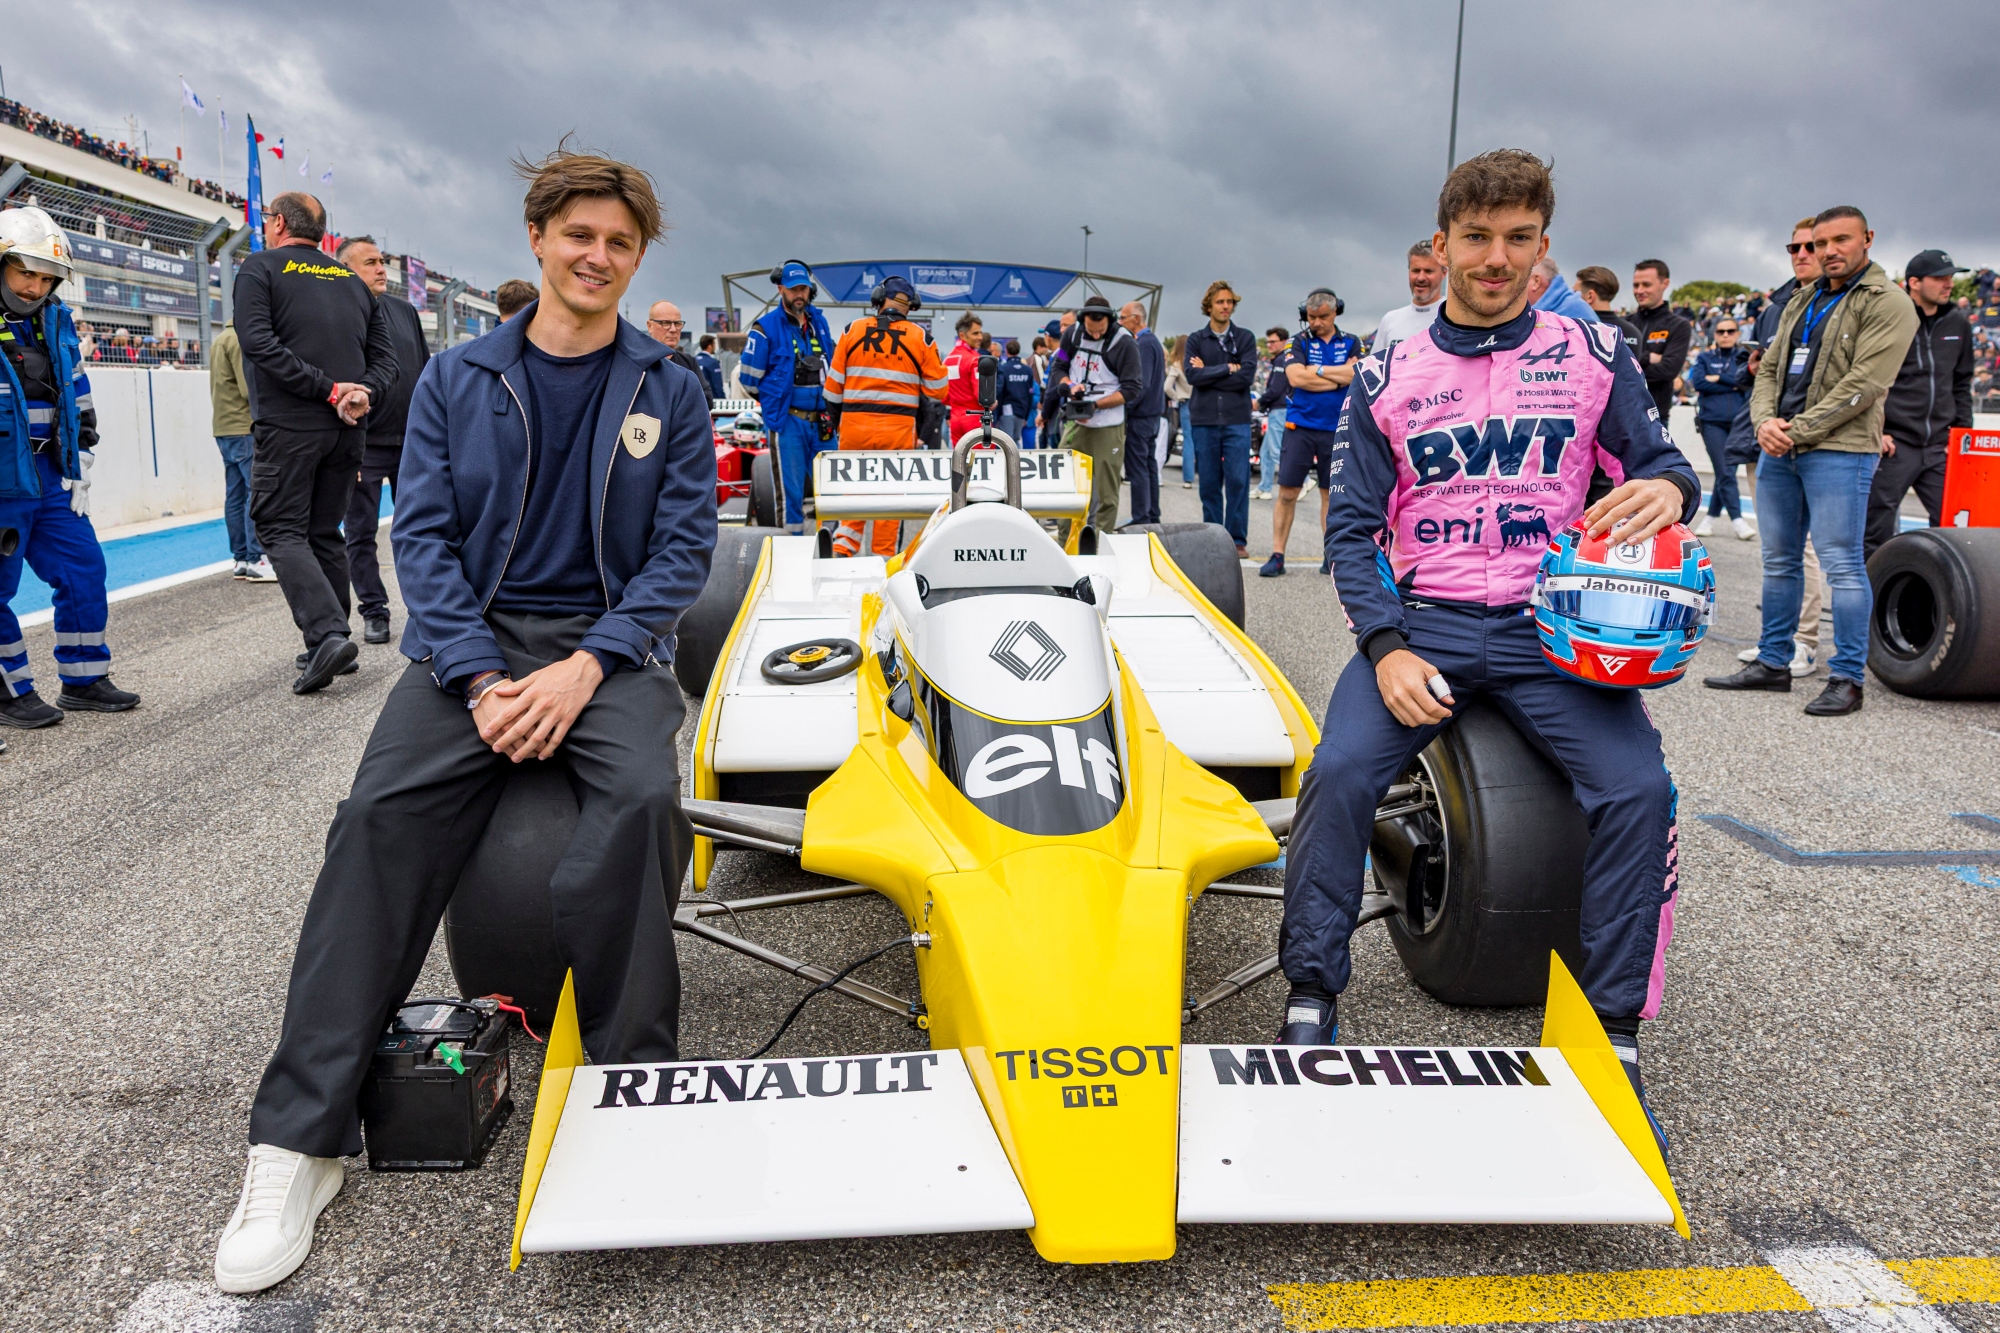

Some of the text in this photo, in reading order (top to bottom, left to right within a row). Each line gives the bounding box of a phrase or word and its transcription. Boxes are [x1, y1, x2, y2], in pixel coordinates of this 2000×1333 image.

[142, 255, 171, 273] ESPACE
[171, 263, 184, 275] VIP
[917, 269, 947, 277] GRAND
[862, 351, 904, 361] TEAM
[1009, 374, 1028, 382] STAFF
[1534, 370, 1568, 382] BWT
[1425, 388, 1463, 409] MSC
[1418, 411, 1466, 427] businessolver
[1404, 414, 1577, 490] BWT
[1975, 436, 2000, 448] HER
[828, 454, 1064, 482] RENAUT elf
[1436, 485, 1480, 495] WATER
[1414, 506, 1484, 544] eni
[953, 548, 1027, 561] RENAULT
[1581, 578, 1670, 600] Jabouille
[965, 725, 1121, 804] elf
[995, 1045, 1174, 1081] TISSOT
[1208, 1048, 1552, 1086] MICHELIN
[593, 1053, 938, 1109] RENAULT
